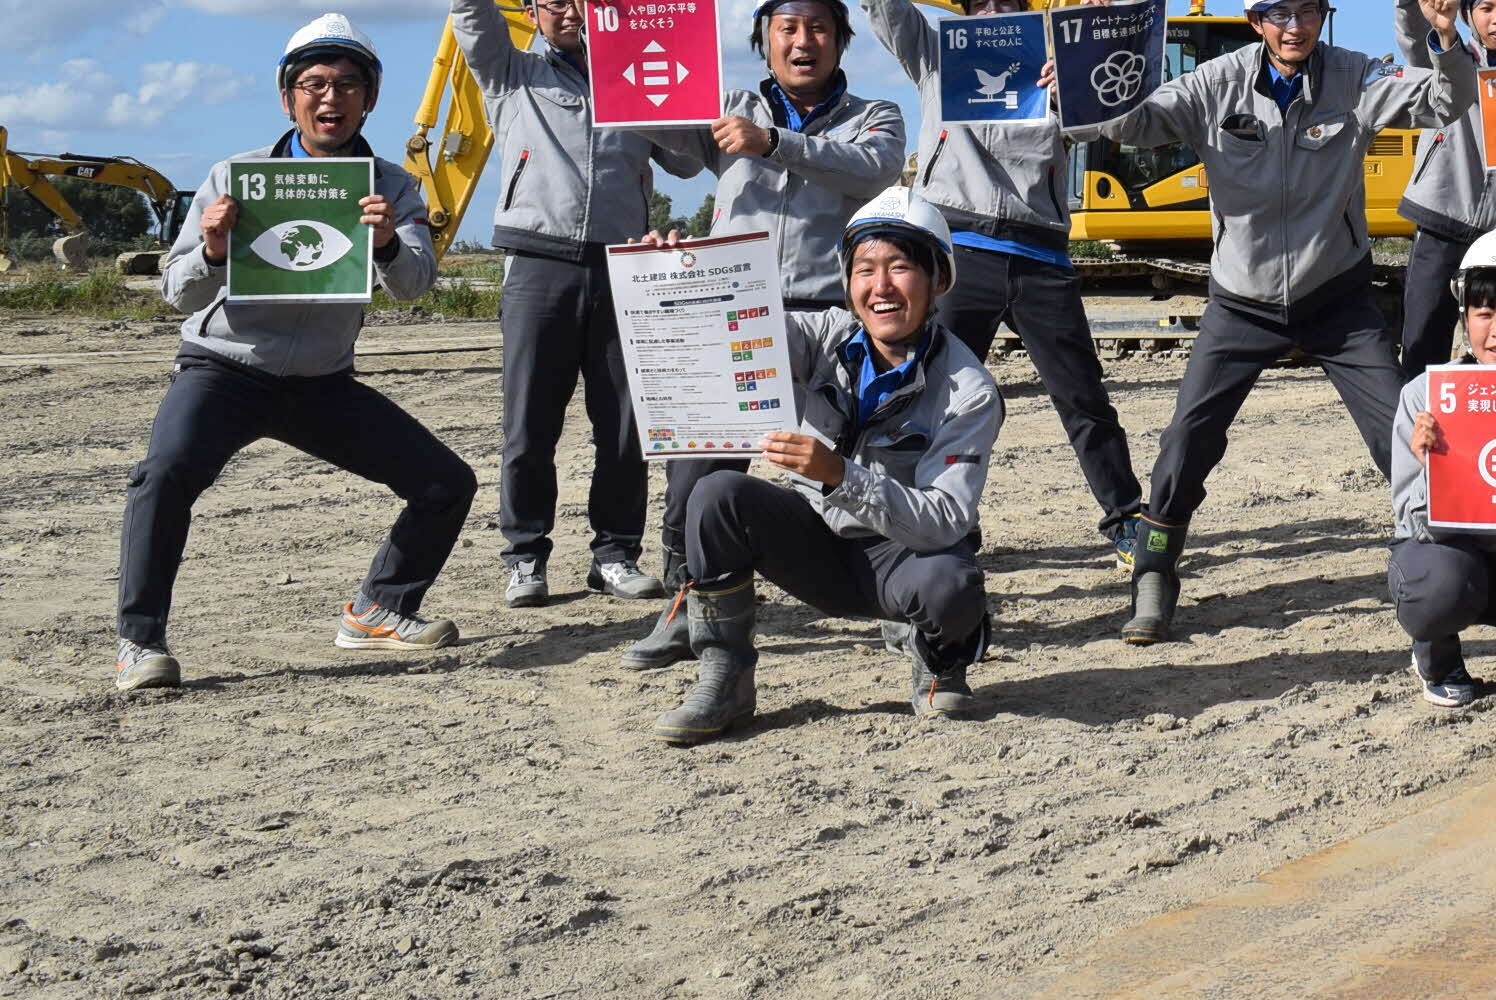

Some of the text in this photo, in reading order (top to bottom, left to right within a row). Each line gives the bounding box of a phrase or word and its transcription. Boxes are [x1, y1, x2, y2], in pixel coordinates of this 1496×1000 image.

[628, 2, 697, 16] 人や国の不平等
[593, 6, 620, 32] 10
[629, 16, 674, 30] をなくそう
[975, 25, 1022, 36] 平和と公正を
[1059, 18, 1082, 44] 17
[946, 28, 968, 50] 16
[975, 36, 1023, 48] すべての人に
[77, 166, 96, 178] CAT
[274, 173, 329, 185] 気候変動に
[238, 173, 266, 200] 13
[274, 188, 349, 200] 具体的な対策を
[631, 273, 667, 283] 北土建設
[670, 269, 707, 280] 株式会社
[1439, 382, 1457, 414] 5
